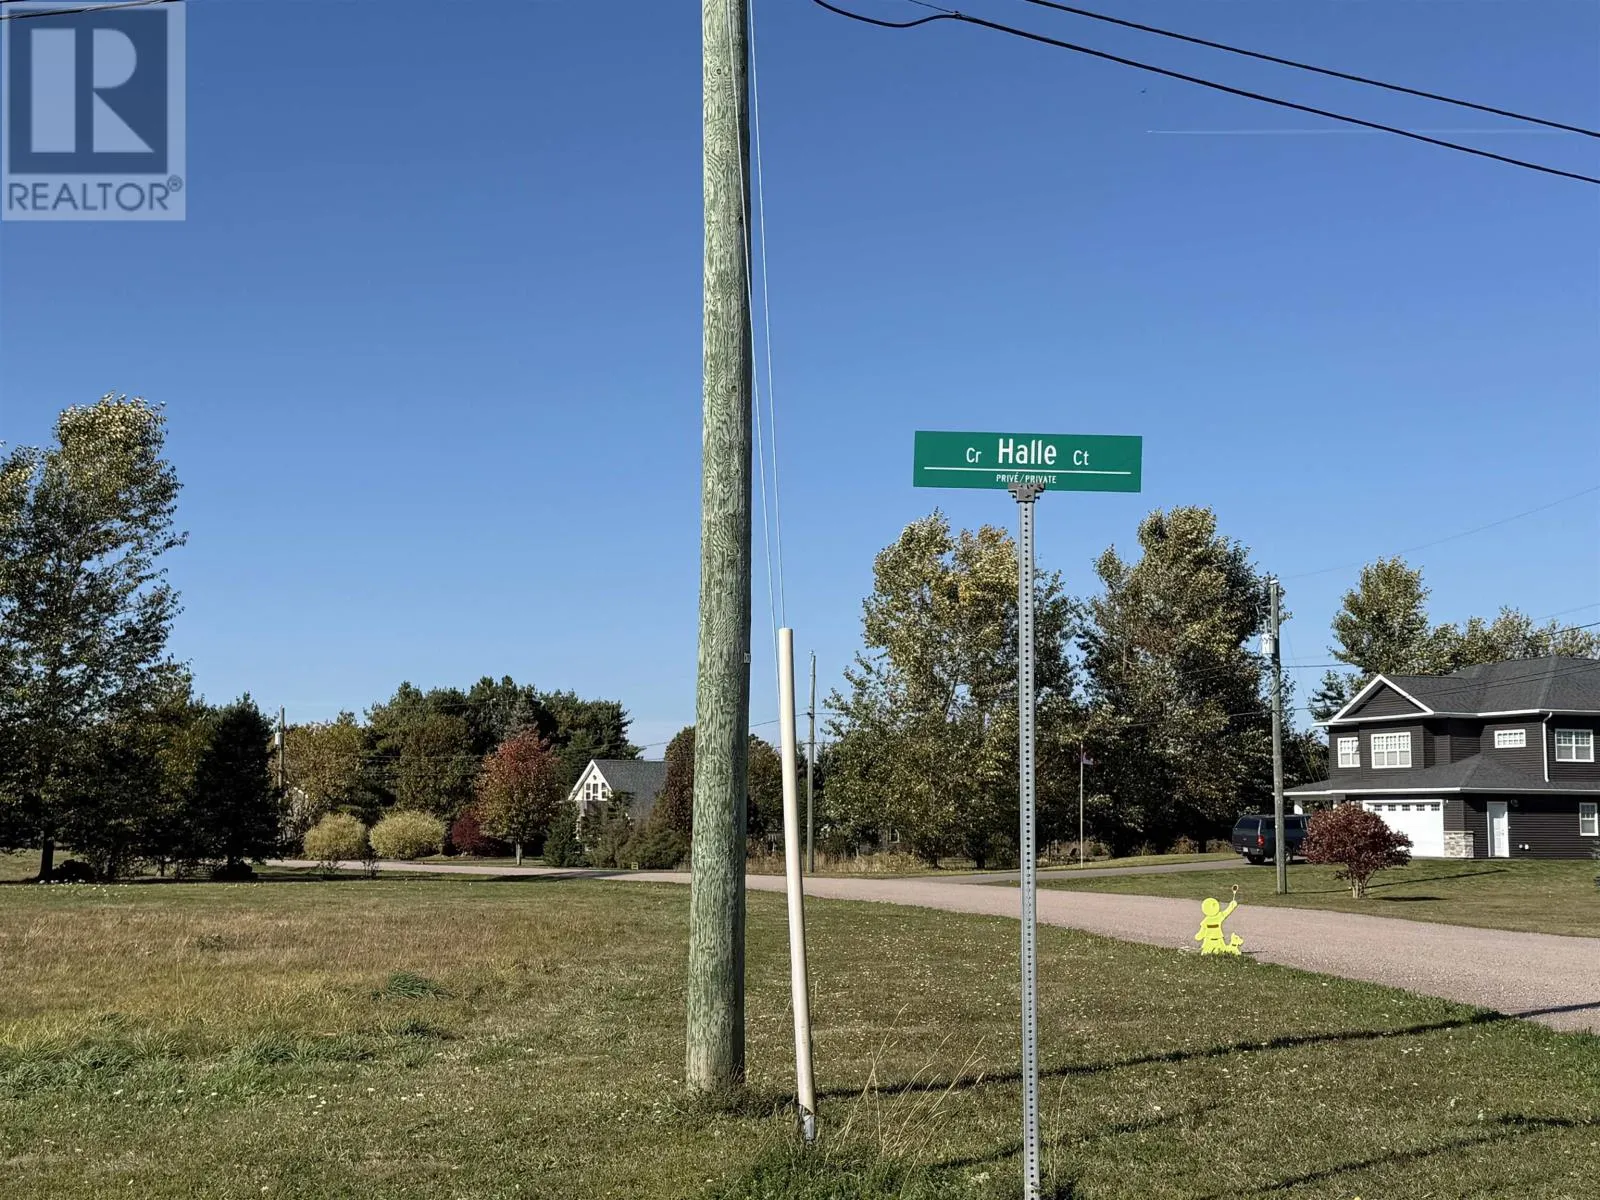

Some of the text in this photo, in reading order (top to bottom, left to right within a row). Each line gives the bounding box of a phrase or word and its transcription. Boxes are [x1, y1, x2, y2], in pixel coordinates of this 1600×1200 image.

[966, 438, 1089, 466] Cr Halle Ct
